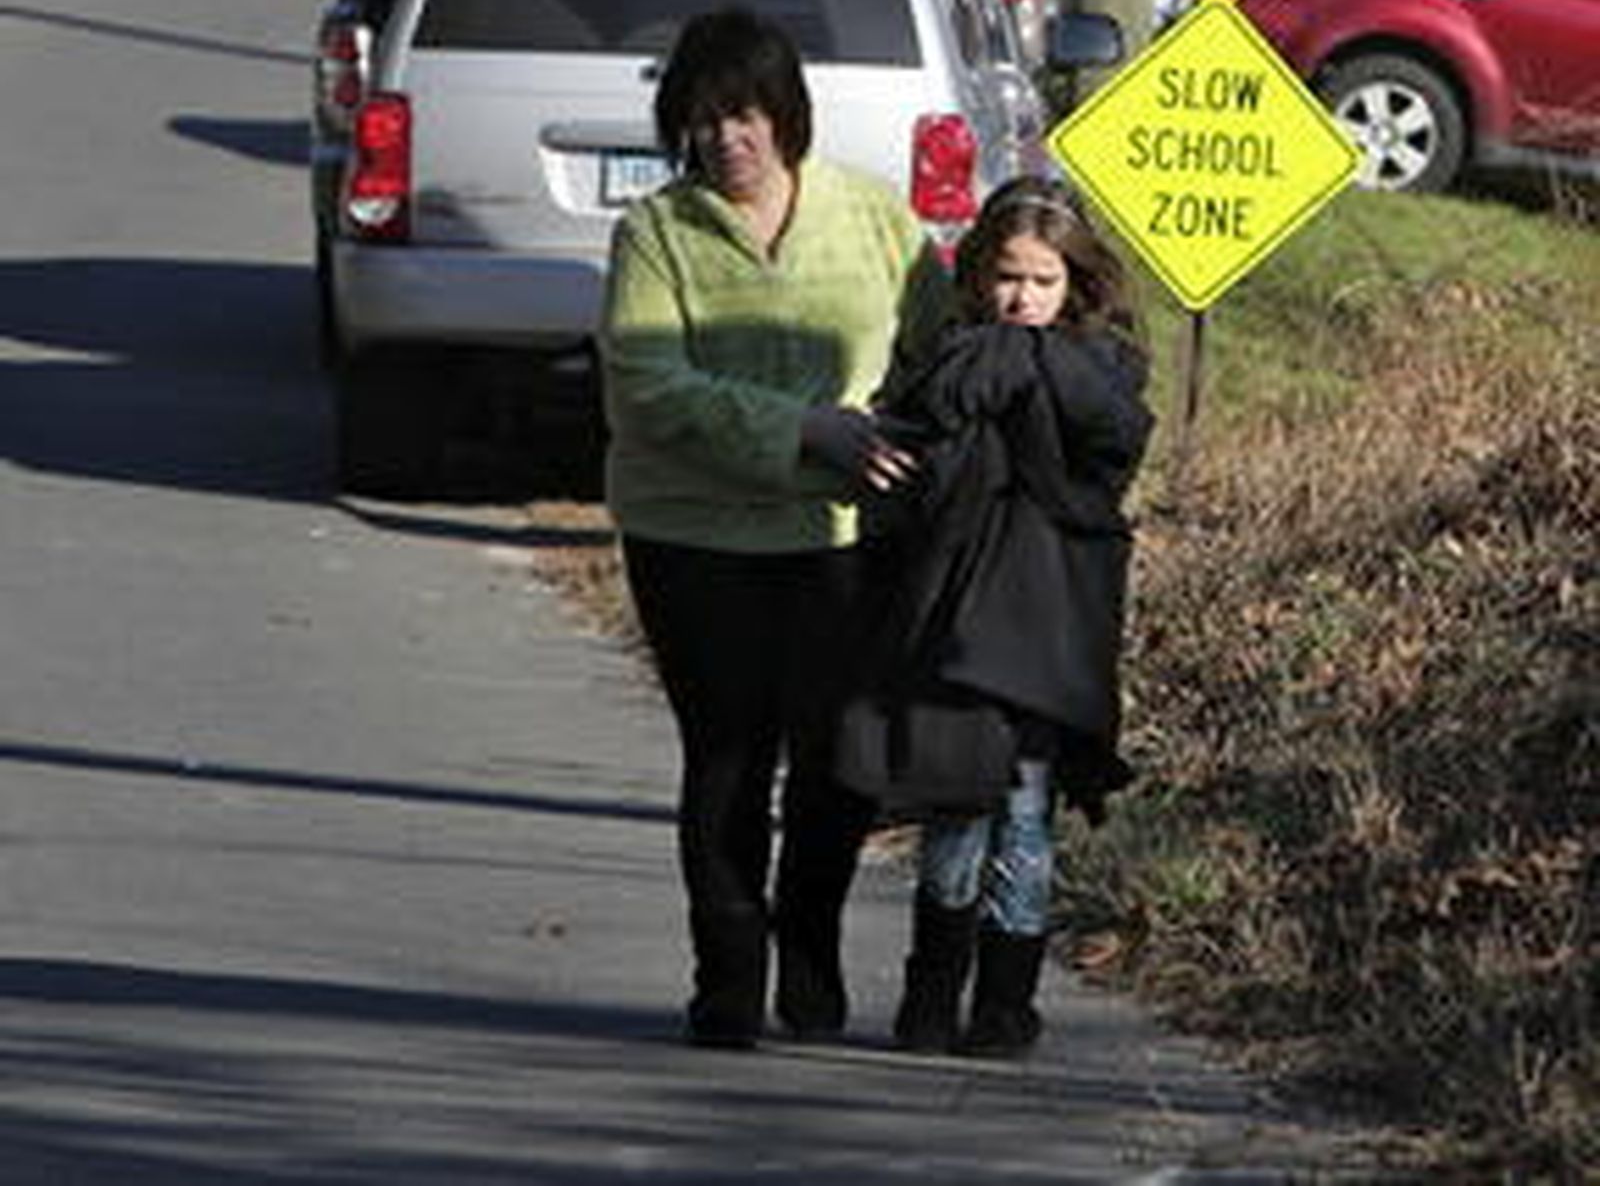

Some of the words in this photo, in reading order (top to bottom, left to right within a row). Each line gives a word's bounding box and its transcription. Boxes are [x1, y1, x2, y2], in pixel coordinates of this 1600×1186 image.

[1157, 67, 1263, 113] SLOW
[1126, 125, 1282, 177] SCHOOL
[1148, 192, 1254, 241] ZONE
